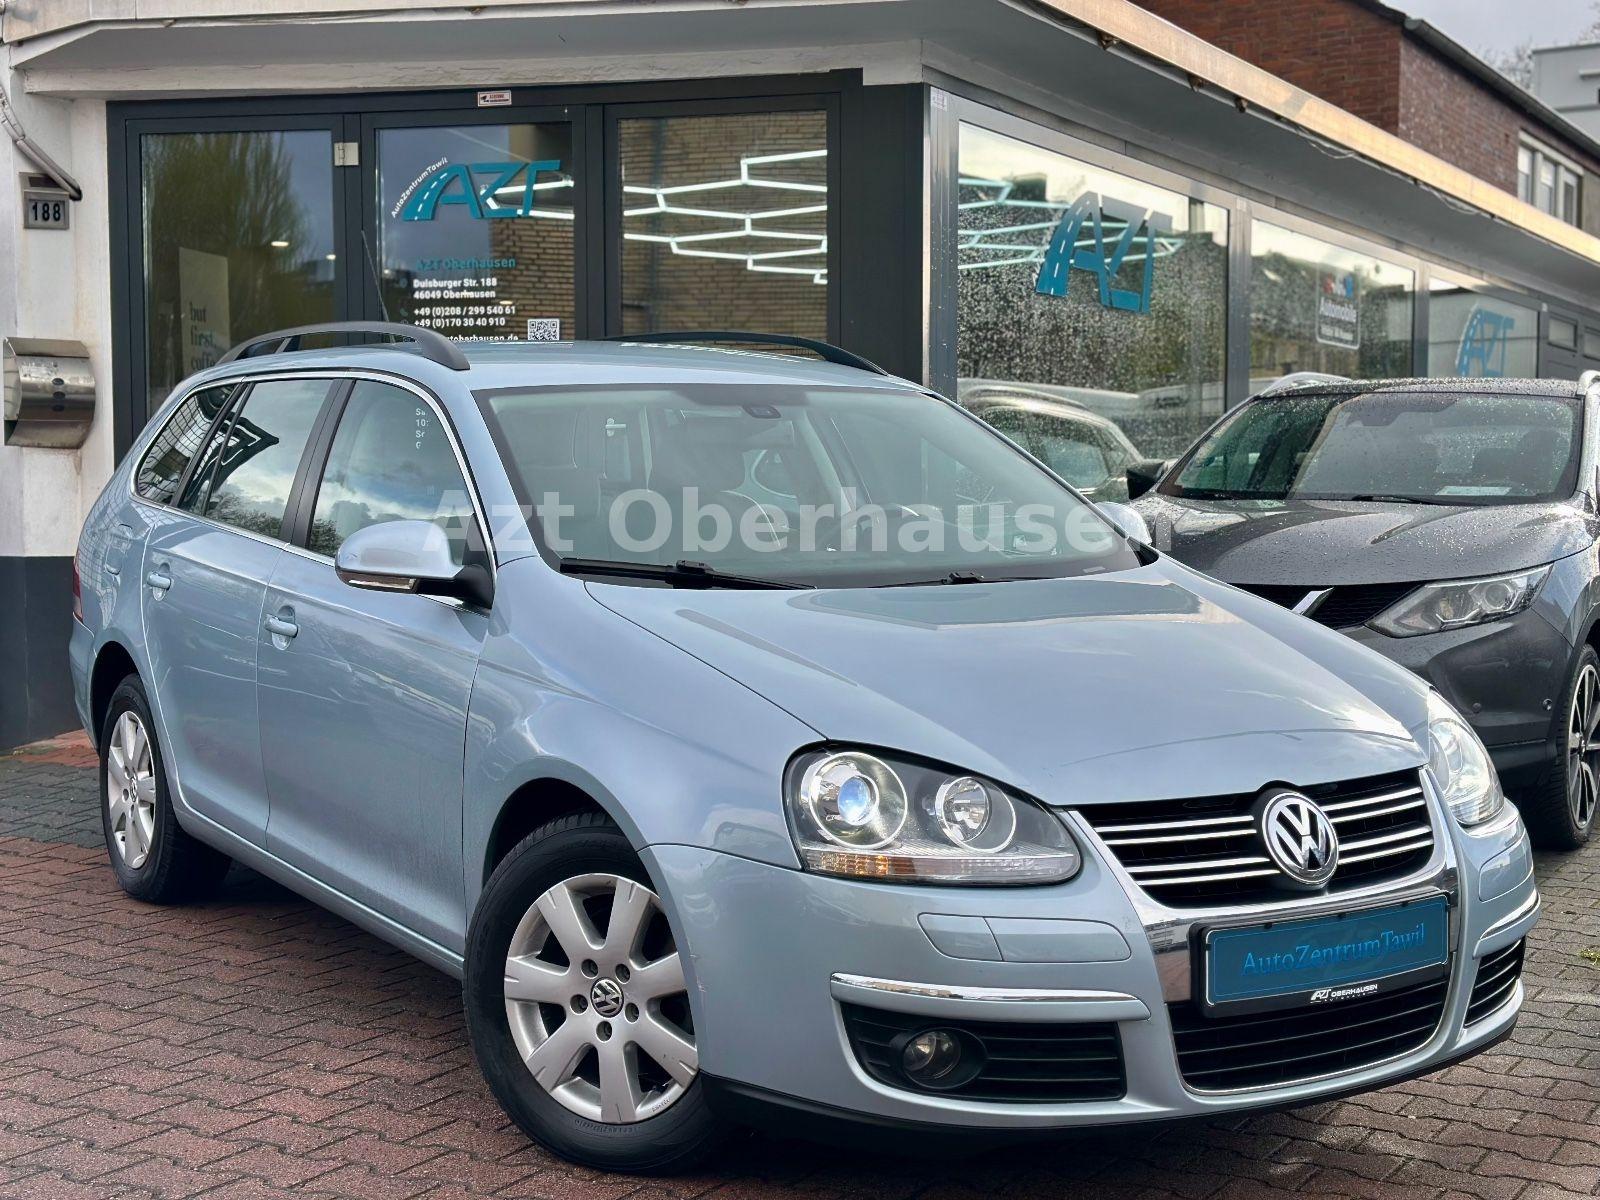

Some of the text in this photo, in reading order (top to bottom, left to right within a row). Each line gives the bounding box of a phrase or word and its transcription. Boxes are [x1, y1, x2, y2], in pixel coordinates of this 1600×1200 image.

[391, 156, 449, 218] AutoZentrumTawil
[402, 159, 561, 221] AZT
[32, 201, 61, 221] 188
[444, 256, 516, 270] Oberhausen
[413, 278, 498, 289] Duisburger Str. 188
[413, 290, 496, 300] 46049 Oberhausen
[414, 307, 431, 316] +49
[432, 306, 461, 317] (0)208
[468, 306, 485, 315] 299
[487, 306, 503, 315] 540
[505, 305, 516, 314] 61
[414, 317, 506, 328] +49 (0)170 30 40 910
[1242, 922, 1425, 976] AutoZentrumTawil
[1331, 983, 1378, 998] OBERHAUSEN
